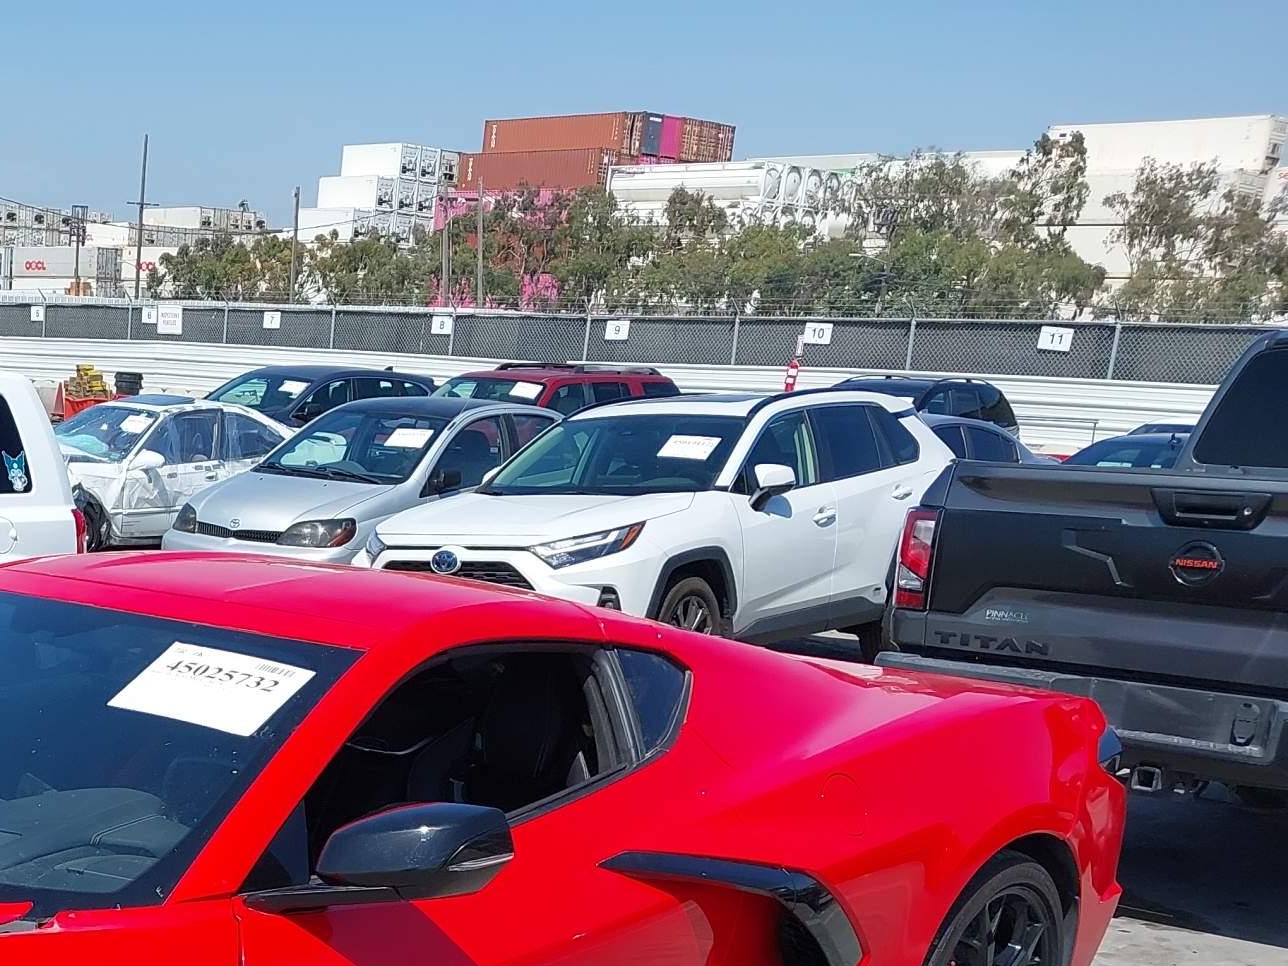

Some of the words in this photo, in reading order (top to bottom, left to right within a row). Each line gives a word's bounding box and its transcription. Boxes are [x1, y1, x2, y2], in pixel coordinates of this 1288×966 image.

[25, 261, 46, 271] OOCL
[269, 315, 276, 324] 7
[439, 320, 446, 330] 8
[613, 325, 622, 335] 9
[812, 327, 825, 339] 10
[1048, 333, 1064, 346] 11
[1175, 558, 1218, 569] NISSAN
[934, 631, 1049, 656] TITAN
[166, 659, 280, 693] 45025732
